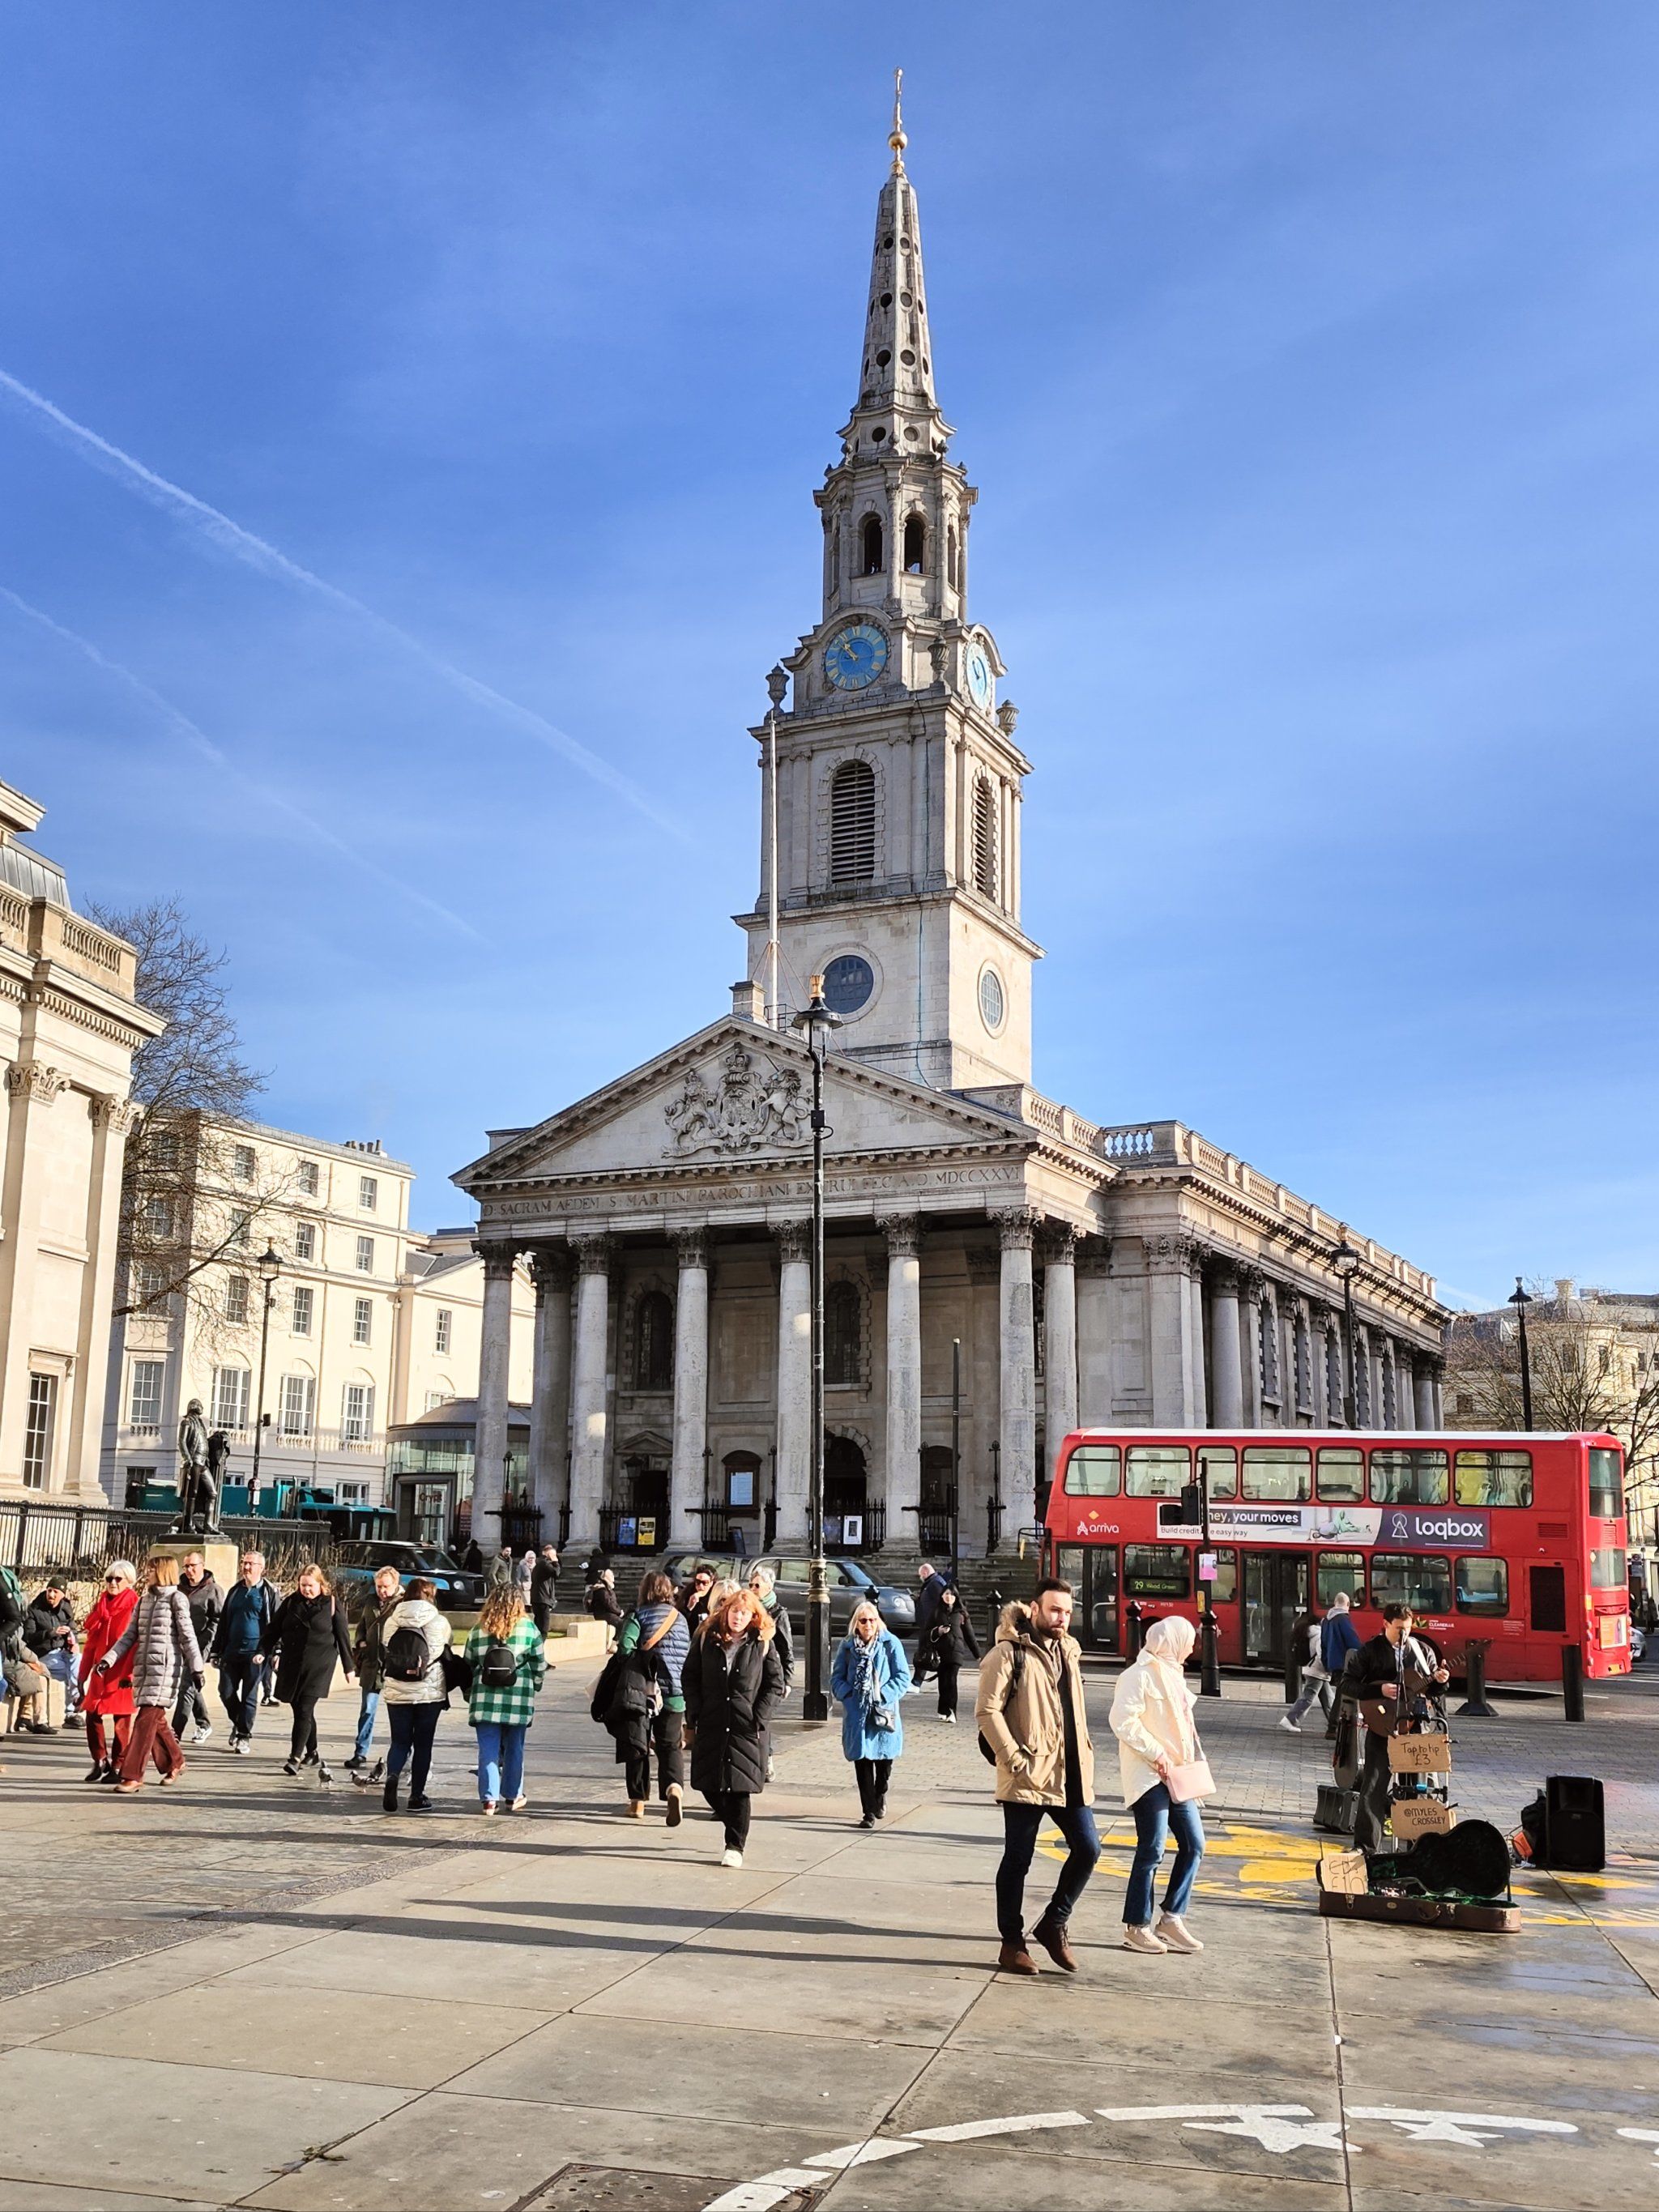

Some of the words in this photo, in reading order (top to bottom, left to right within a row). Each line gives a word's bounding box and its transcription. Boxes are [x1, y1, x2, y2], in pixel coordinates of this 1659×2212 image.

[500, 1200, 552, 1216] SACRAM
[557, 1197, 600, 1211] AEDEM
[626, 1191, 689, 1207] MARTINI
[698, 1183, 789, 1202] PAROCHIANI
[936, 1166, 1019, 1185] MDCCXXVI
[1209, 1512, 1230, 1524] ney,
[1232, 1512, 1259, 1524] your
[1260, 1513, 1299, 1524] moves
[1089, 1524, 1120, 1534] arriva
[1161, 1526, 1178, 1534] Build
[1234, 1529, 1248, 1537] way
[1415, 1517, 1484, 1541] loqbox
[1134, 1580, 1144, 1590] 29
[1401, 1741, 1417, 1756] Tap
[1418, 1743, 1427, 1754] to
[1428, 1743, 1439, 1756] tip
[1414, 1754, 1431, 1766] £3
[1404, 1807, 1438, 1818] @MYLES
[1412, 1816, 1446, 1826] CROSSLEY
